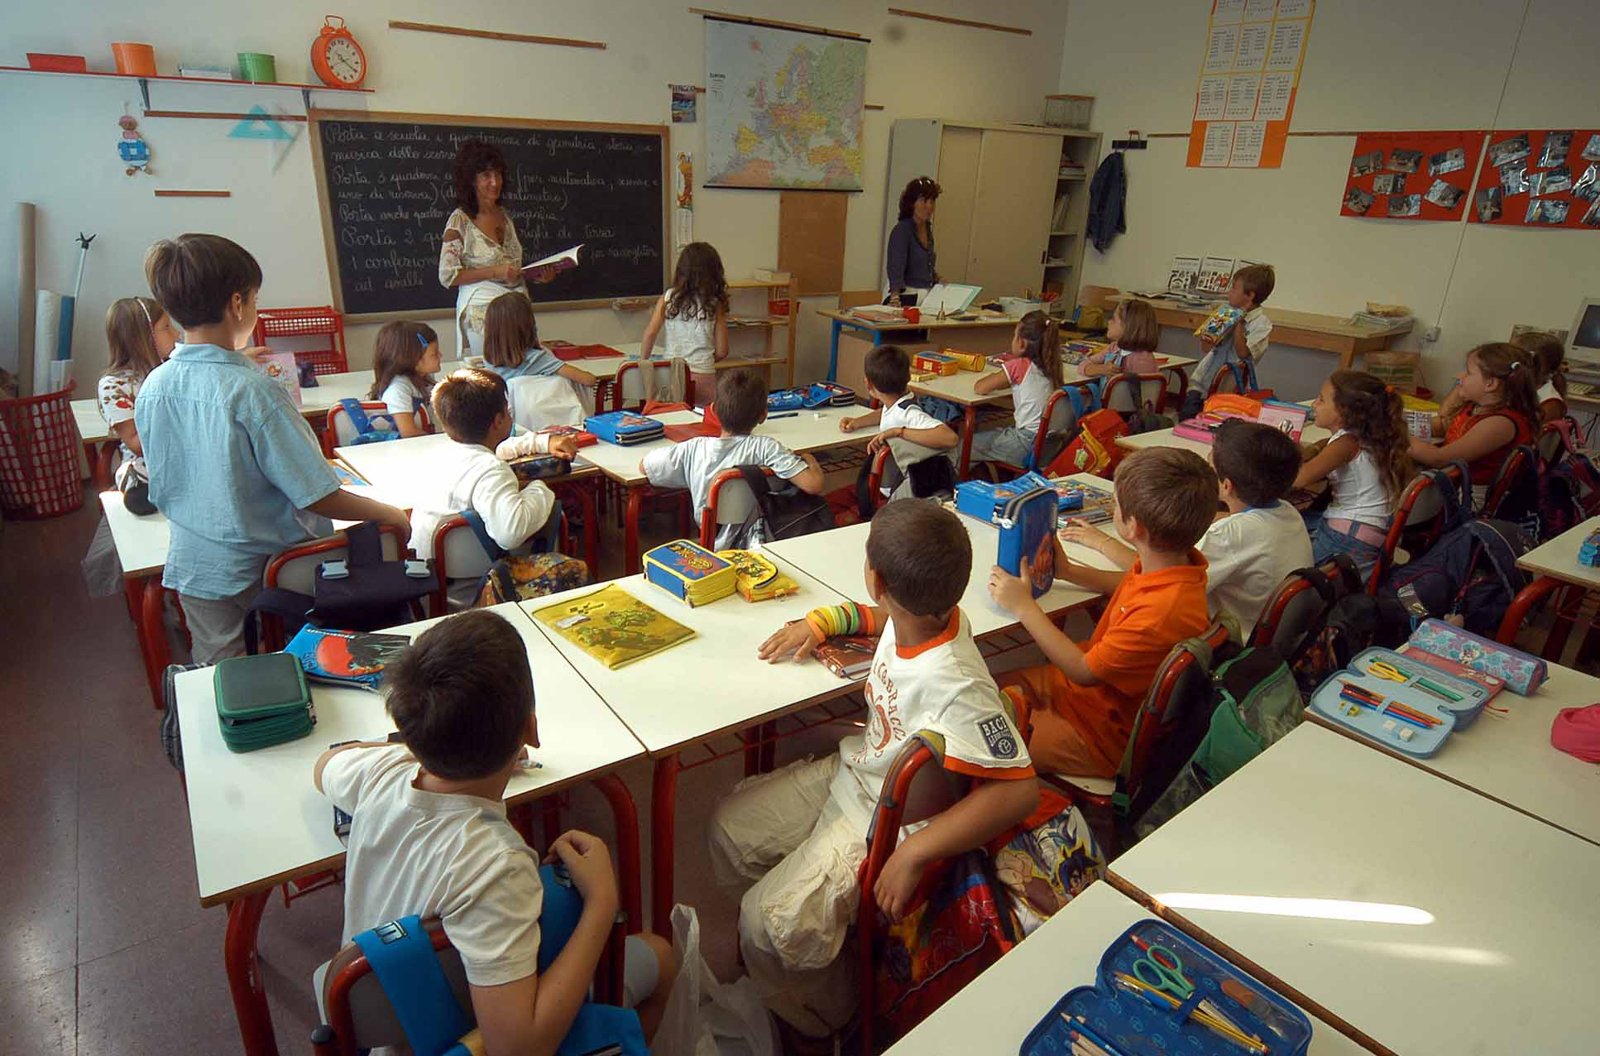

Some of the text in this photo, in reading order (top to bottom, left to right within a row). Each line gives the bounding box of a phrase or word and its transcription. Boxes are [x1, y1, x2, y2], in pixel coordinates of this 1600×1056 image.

[326, 123, 366, 144] Porta
[386, 125, 429, 141] scuola
[331, 165, 371, 185] Porta
[340, 203, 374, 222] Porta
[342, 225, 397, 247] Porta
[365, 248, 439, 277] confezion
[982, 716, 1007, 736] BACI
